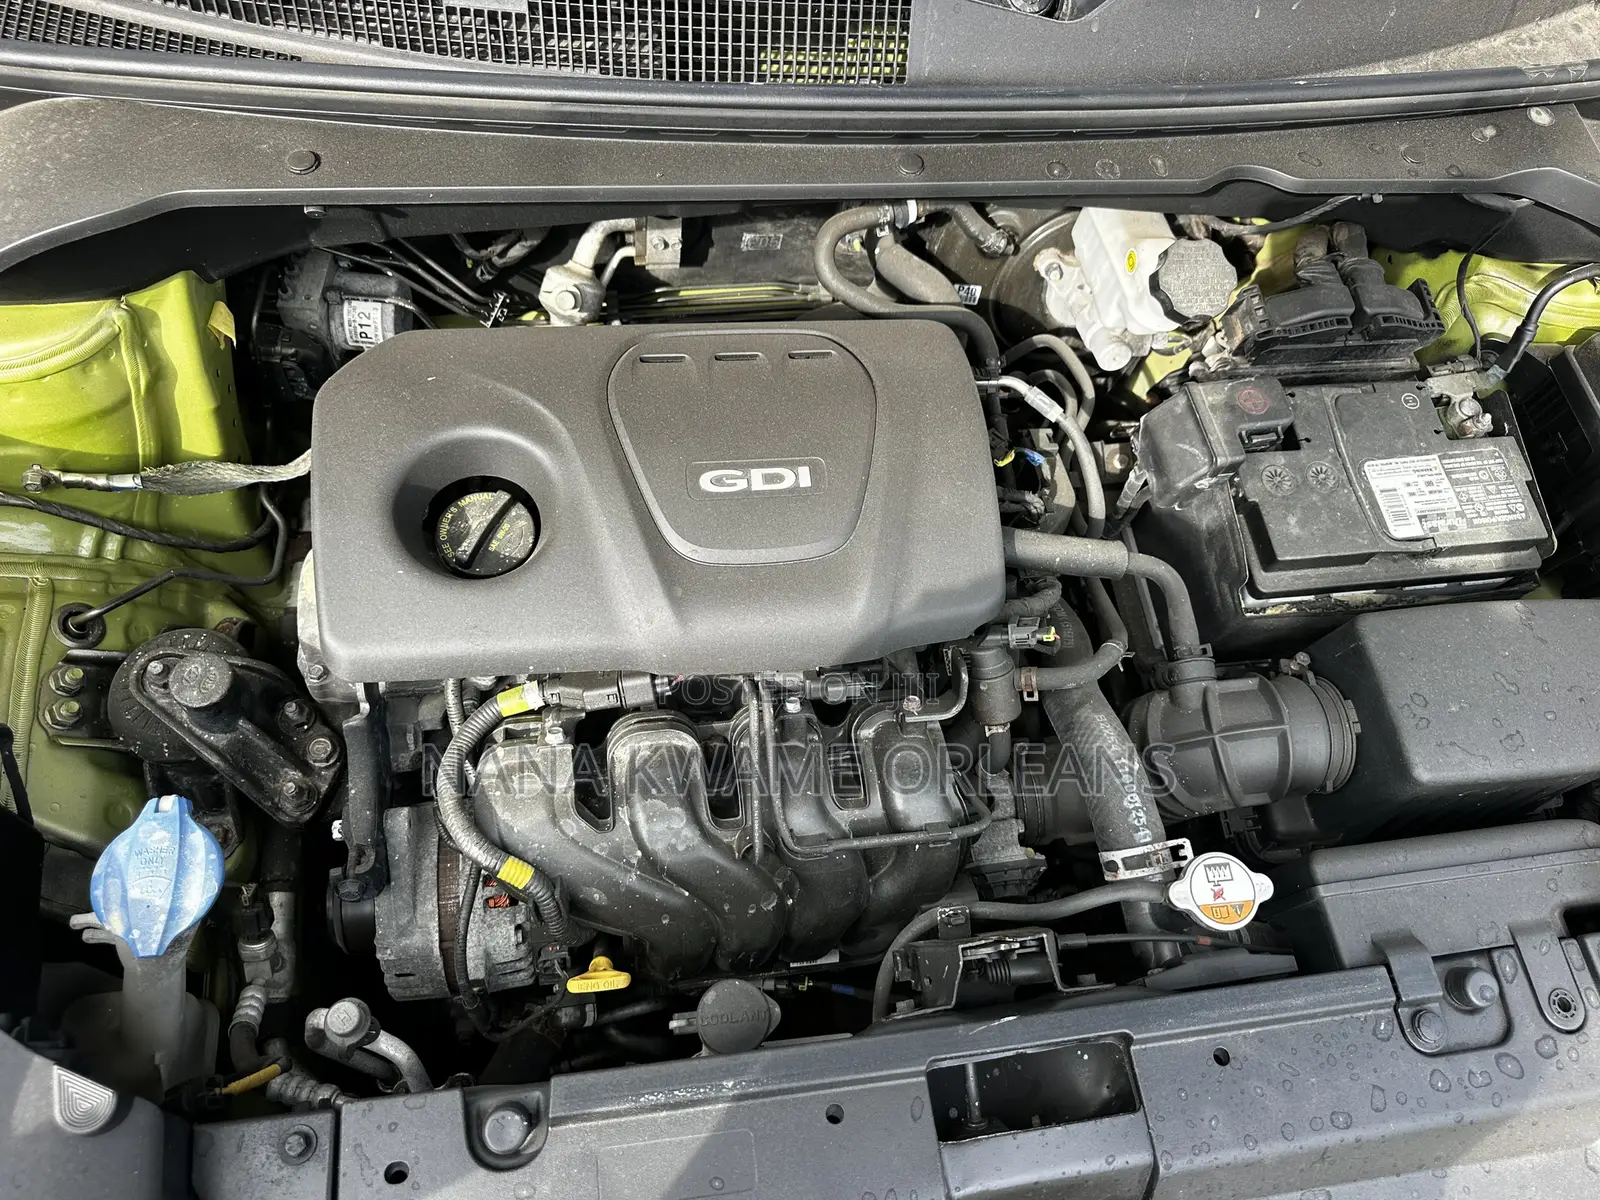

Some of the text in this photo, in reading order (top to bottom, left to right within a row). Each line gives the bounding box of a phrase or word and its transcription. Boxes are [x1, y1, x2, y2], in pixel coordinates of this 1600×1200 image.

[957, 285, 977, 297] P40
[357, 311, 373, 340] P12
[699, 466, 812, 493] GDI
[440, 492, 494, 558] SEE OWNER'S MANUAL
[488, 539, 500, 552] SAE
[134, 846, 176, 857] WASHER
[140, 854, 165, 866] ONLY
[700, 1009, 770, 1027] COOLANT
